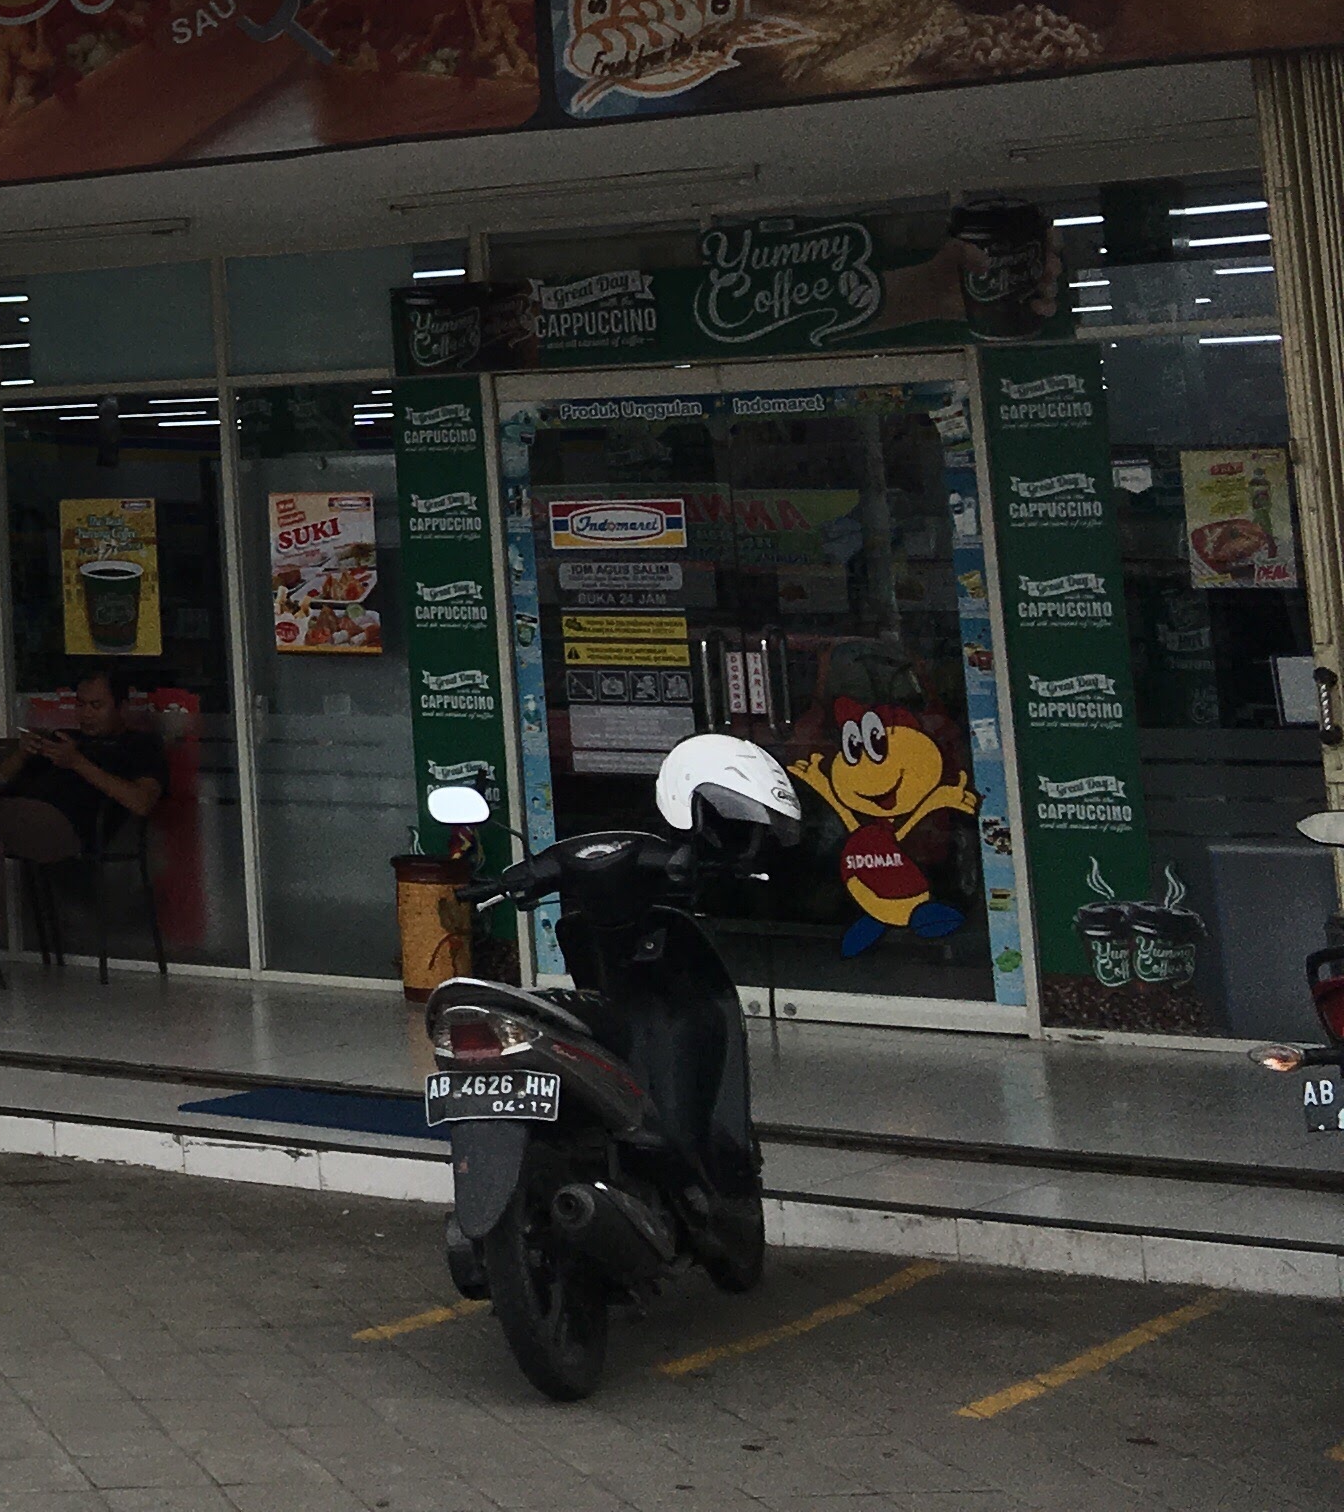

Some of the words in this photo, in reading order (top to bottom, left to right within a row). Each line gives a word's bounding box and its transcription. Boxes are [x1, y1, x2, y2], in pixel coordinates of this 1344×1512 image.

[702, 228, 853, 272] Yummy
[553, 284, 595, 307] Great
[596, 271, 630, 293] Day
[708, 267, 837, 329] Coffee
[534, 306, 658, 338] CAPPUCCINO
[560, 401, 620, 420] Produk
[621, 399, 703, 422] Unggulan
[732, 394, 826, 415] Indomaret
[999, 401, 1093, 420] CAPPUCCINO
[403, 428, 477, 444] CAPPUCCINO
[1009, 500, 1103, 519] CAPPUCCINO
[278, 517, 342, 550] SUKI
[409, 516, 482, 532] CAPPUCCINO
[575, 515, 659, 534] Indomaret
[596, 564, 630, 575] AGUS
[633, 564, 670, 575] SALIM
[577, 593, 616, 605] BUKA
[638, 592, 668, 605] JAM
[415, 605, 488, 620] CAPPUCCINO
[1017, 601, 1113, 618] CAPPUCCINO
[420, 694, 495, 711] CAPPUCCINO
[1028, 701, 1123, 719] CAPPUCCINO
[1037, 803, 1133, 822] CAPPUCCINO
[845, 852, 904, 869] SIDOMAR
[428, 1075, 451, 1100] AB
[461, 1074, 513, 1096] 4626
[525, 1074, 556, 1099] HW
[1303, 1079, 1334, 1106] AB
